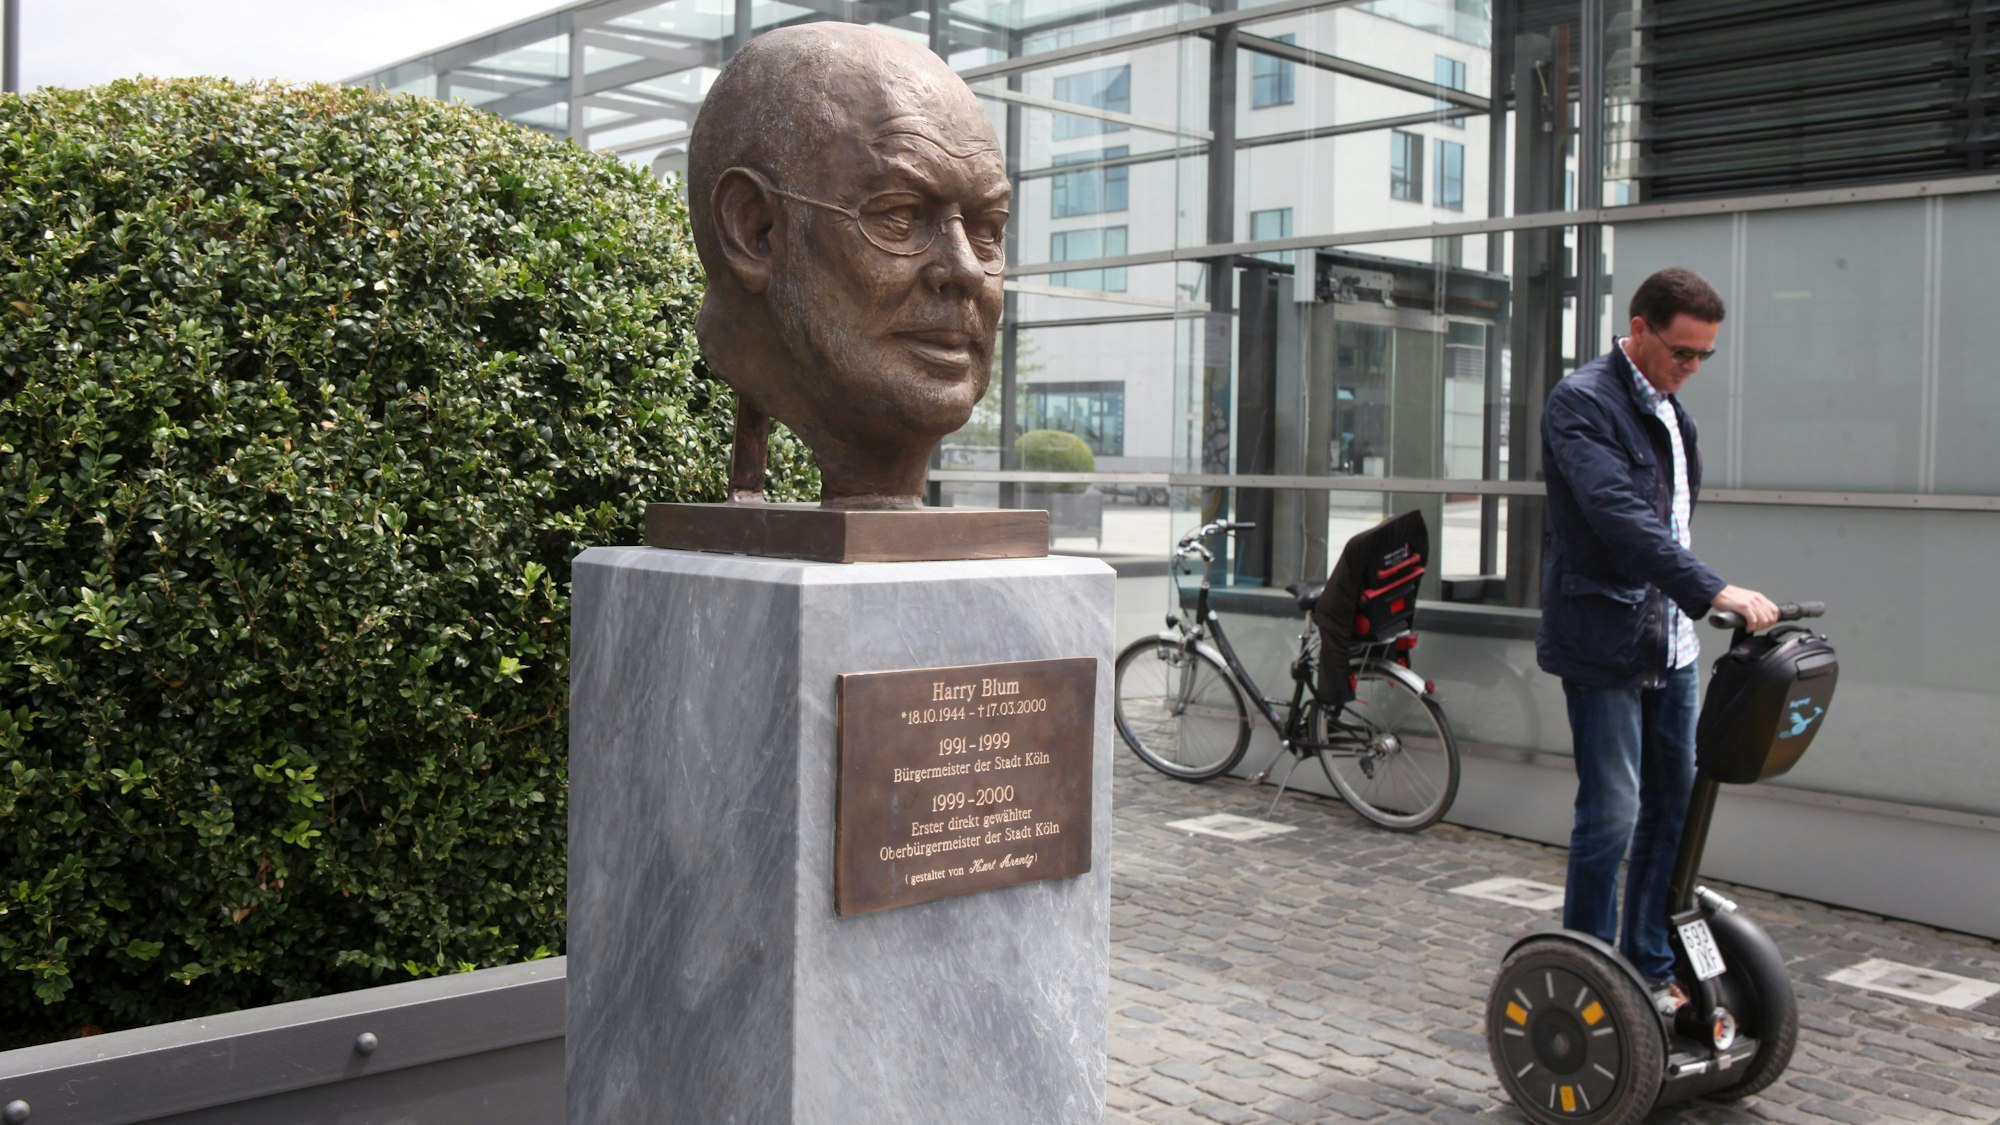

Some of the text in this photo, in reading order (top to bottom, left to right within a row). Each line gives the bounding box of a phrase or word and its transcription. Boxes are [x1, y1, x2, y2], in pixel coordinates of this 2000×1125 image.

[932, 679, 1020, 702] Harry Blum
[894, 752, 1050, 783] Bürgermeister der Stadt Köln
[911, 808, 1032, 837] Erster direkt gewählter
[879, 823, 1060, 861] Oberbürgermeister der Stadt Köln
[949, 867, 964, 877] von
[969, 860, 995, 874] Kurt
